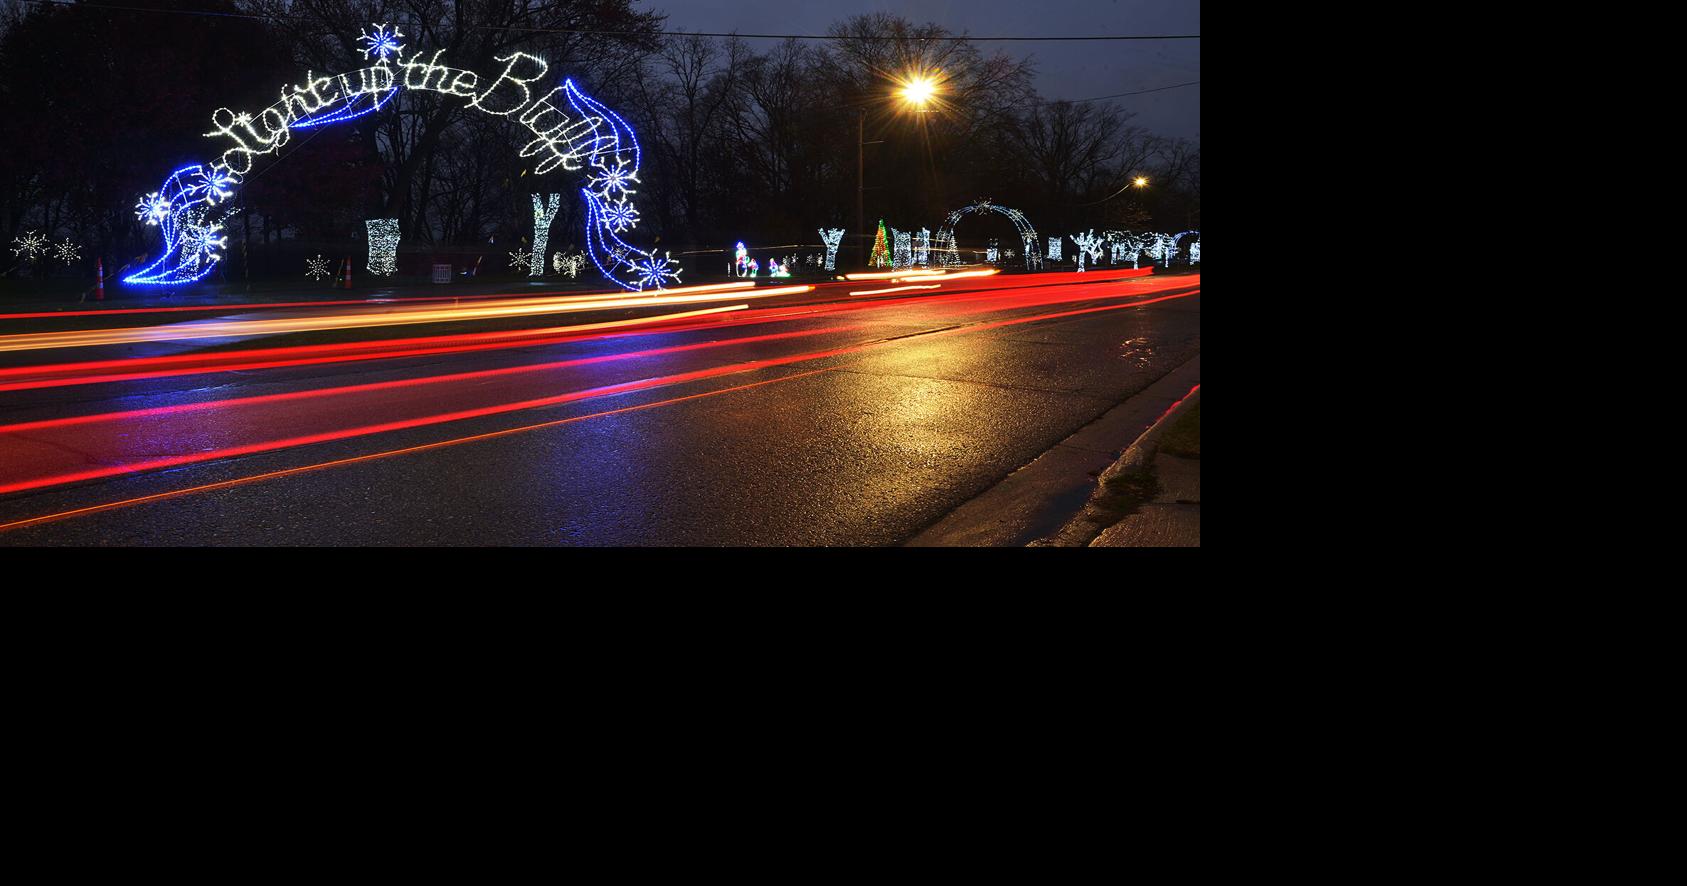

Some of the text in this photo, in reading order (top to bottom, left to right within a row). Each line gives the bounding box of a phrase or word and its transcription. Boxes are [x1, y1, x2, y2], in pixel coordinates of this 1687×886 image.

[202, 48, 618, 175] Light up the Bluff
